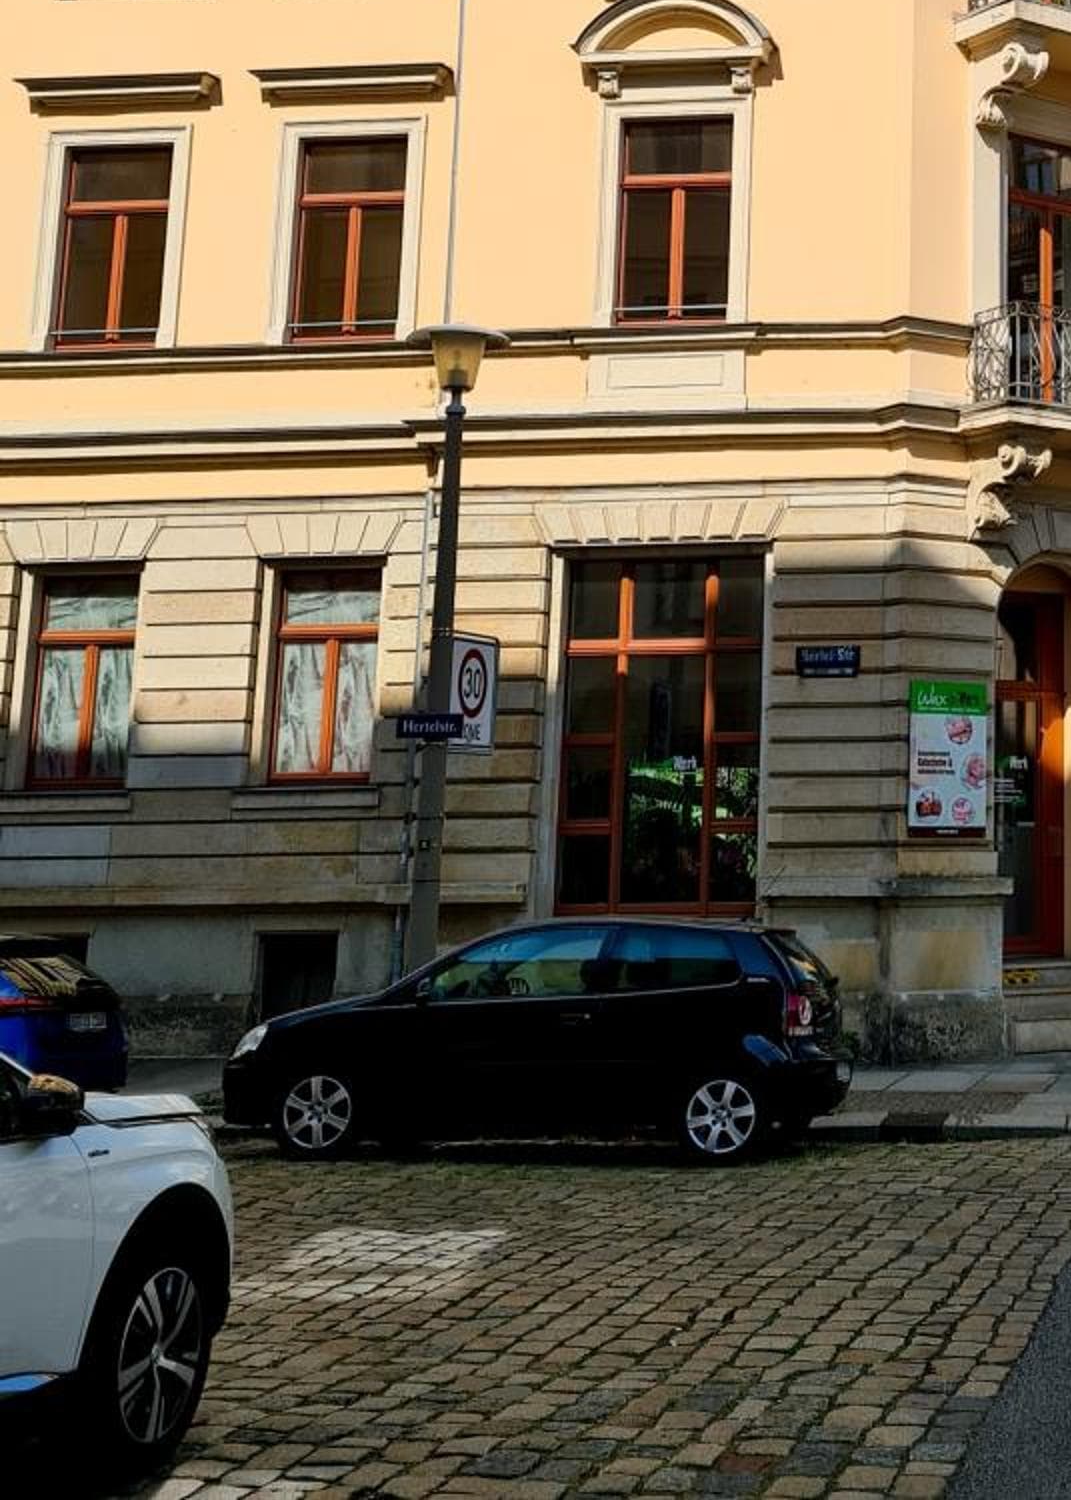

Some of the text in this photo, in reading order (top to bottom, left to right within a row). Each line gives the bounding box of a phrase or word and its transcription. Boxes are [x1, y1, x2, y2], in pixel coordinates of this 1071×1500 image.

[463, 667, 481, 699] 30
[403, 720, 457, 733] Hertelstr.
[464, 723, 481, 741] ONE
